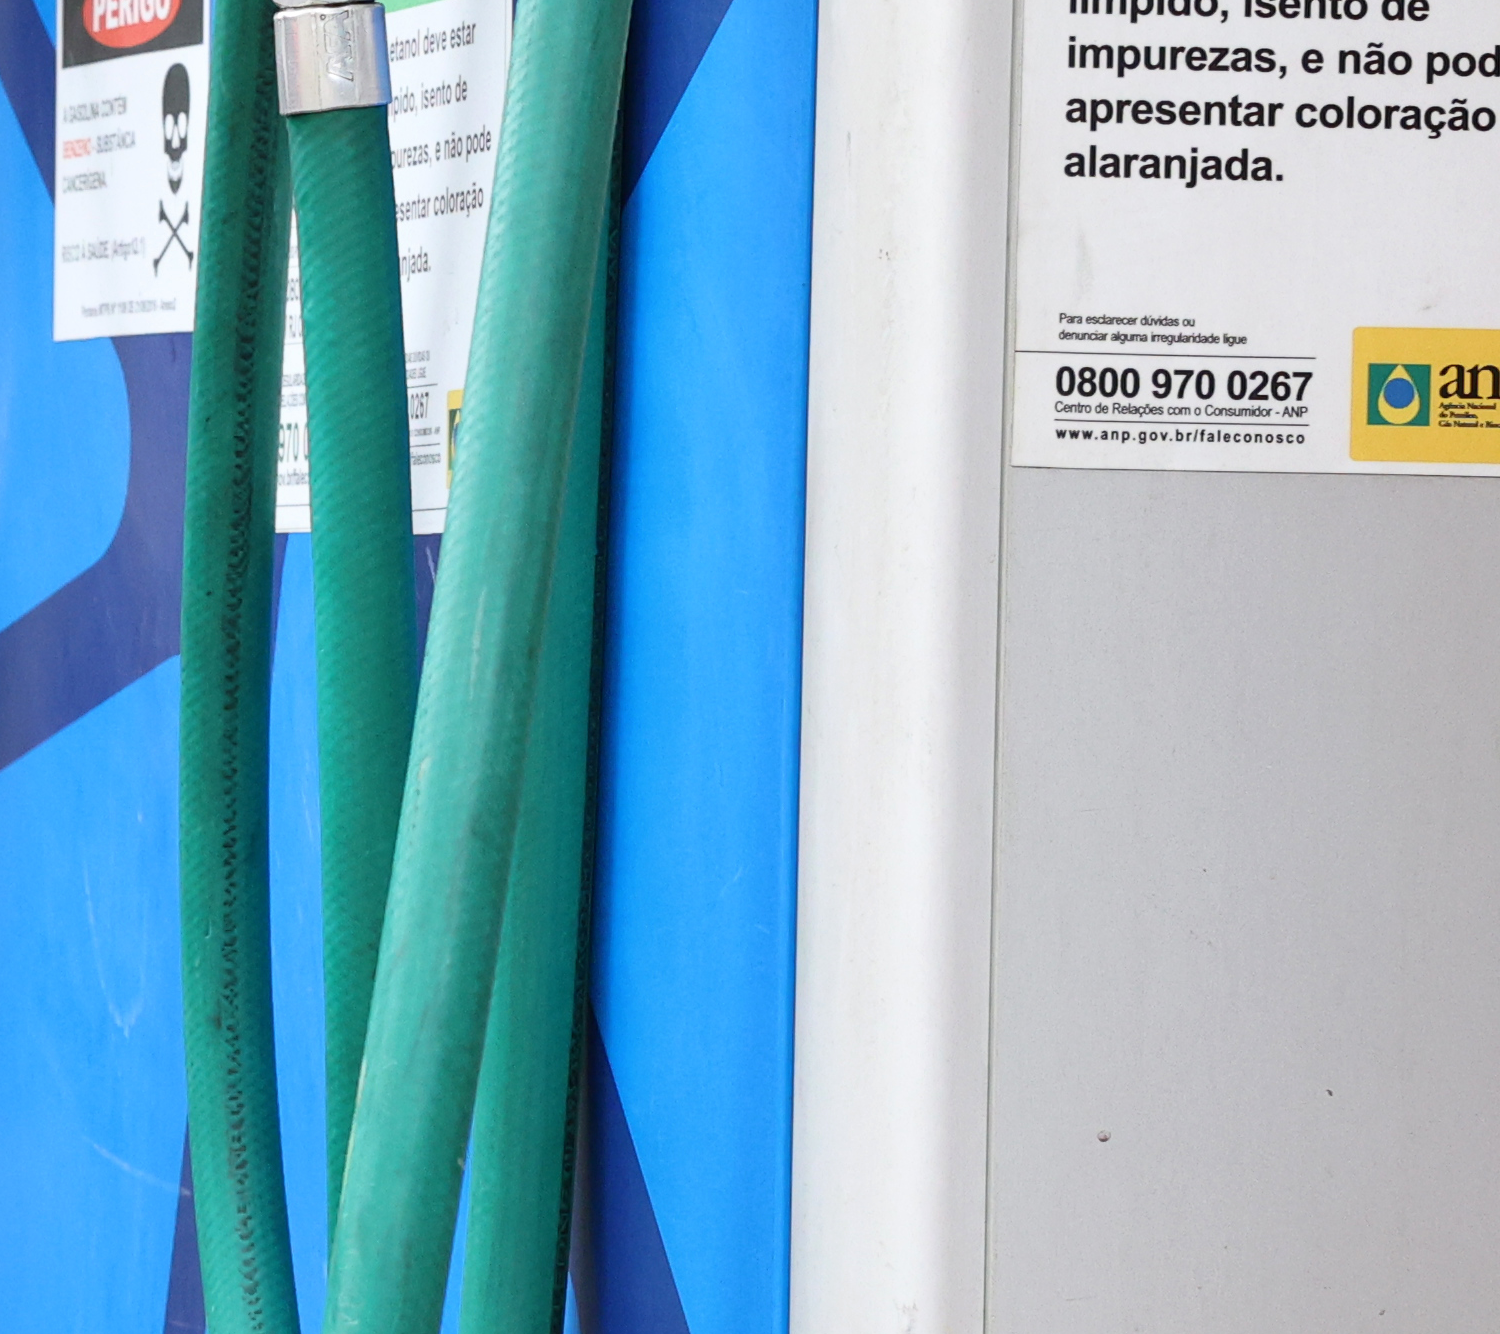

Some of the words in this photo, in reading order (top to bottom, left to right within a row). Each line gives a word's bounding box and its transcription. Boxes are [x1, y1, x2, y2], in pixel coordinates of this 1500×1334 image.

[389, 29, 420, 62] etanol
[423, 27, 447, 54] deve
[450, 20, 476, 49] estar
[1067, 37, 1288, 80] impurezas,
[1301, 49, 1324, 74] e
[1338, 42, 1412, 76] não
[421, 83, 452, 111] isento
[455, 75, 468, 102] de
[1065, 94, 1283, 134] apresentar
[1295, 98, 1496, 139] coloração
[435, 146, 441, 162] e
[444, 132, 463, 159] não
[466, 124, 492, 163] pode
[1064, 146, 1284, 188] alaranjada.
[433, 182, 484, 218] coloração
[1058, 329, 1108, 341] denunciar
[1110, 331, 1148, 344] alguma
[1150, 332, 1220, 345] irregularidade
[1223, 333, 1248, 346] ligue
[1059, 313, 1083, 325] Para
[1085, 314, 1138, 326] esclarecer
[1140, 314, 1180, 327] dúvidas
[1182, 318, 1195, 327] ou
[1055, 366, 1141, 398] 0800
[1152, 369, 1216, 400] 970
[1227, 371, 1314, 402] 0267
[1054, 401, 1092, 414] Centro
[1094, 402, 1109, 415] de
[1112, 403, 1164, 417] Relações
[1167, 406, 1191, 416] com
[1193, 407, 1201, 416] o
[1204, 403, 1273, 417] Consumidor
[1282, 406, 1309, 418] ANP
[1055, 428, 1306, 445] www.anp.gov.br/faleconosco
